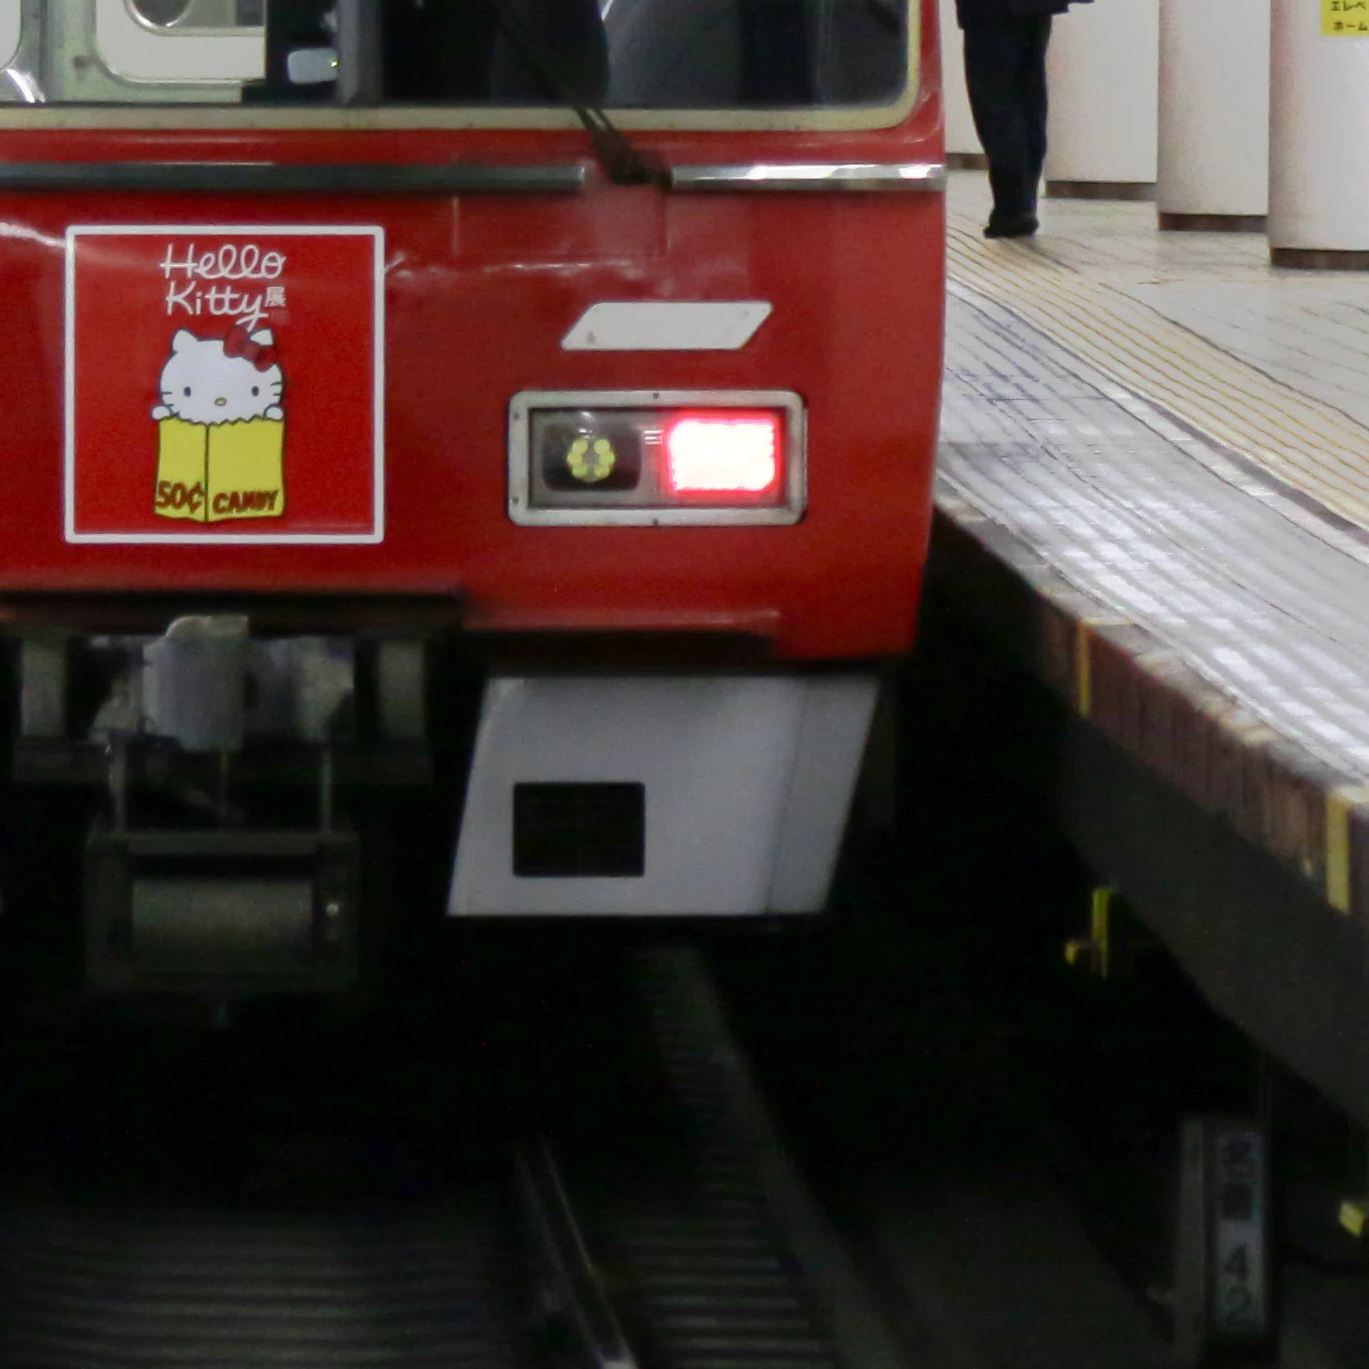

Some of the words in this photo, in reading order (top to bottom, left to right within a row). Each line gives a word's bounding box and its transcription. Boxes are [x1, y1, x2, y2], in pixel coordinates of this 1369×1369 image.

[160, 242, 286, 281] Hello
[165, 281, 269, 328] Kitty
[264, 286, 286, 309] 展
[155, 481, 206, 512] 50¢
[212, 488, 280, 515] CANDY
